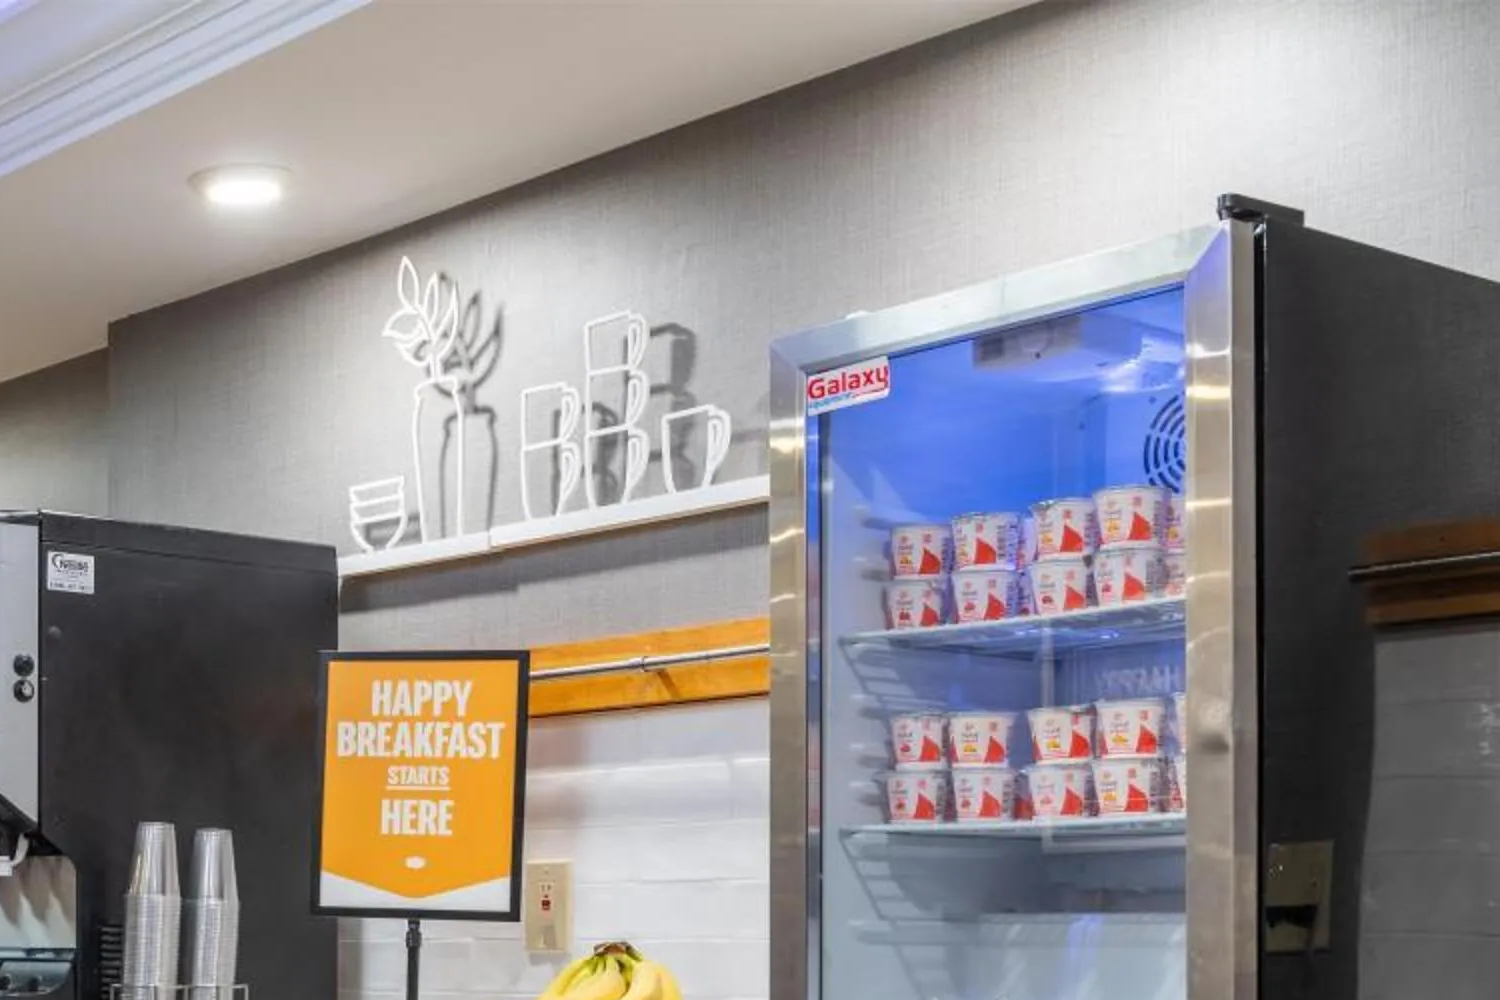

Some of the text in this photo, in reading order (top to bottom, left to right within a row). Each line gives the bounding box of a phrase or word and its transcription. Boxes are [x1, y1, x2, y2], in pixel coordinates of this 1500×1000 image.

[808, 366, 889, 399] Galaxy
[371, 679, 473, 717] HAPPY
[337, 721, 506, 759] BREAKFAST
[387, 765, 450, 785] STARTS
[380, 799, 454, 836] HERE
